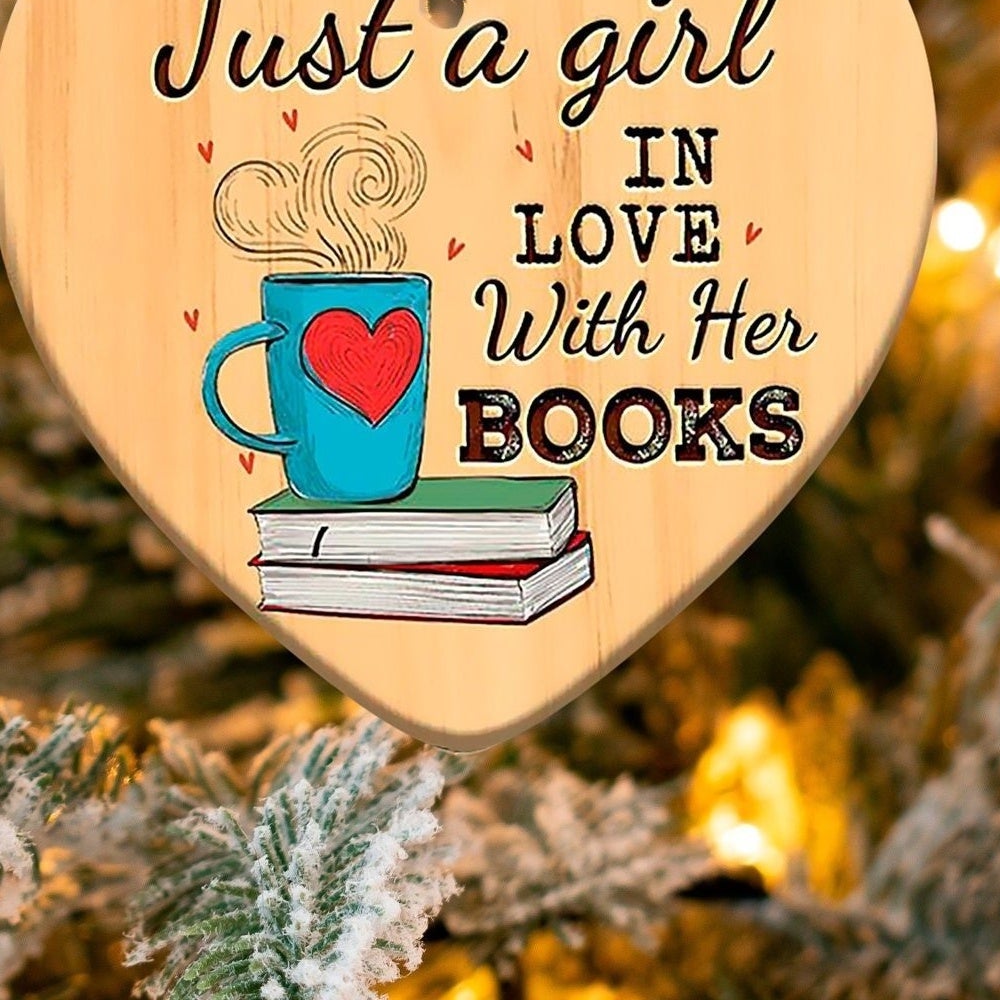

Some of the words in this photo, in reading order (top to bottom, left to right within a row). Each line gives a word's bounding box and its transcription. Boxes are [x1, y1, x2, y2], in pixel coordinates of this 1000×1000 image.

[442, 18, 528, 88] a
[624, 126, 719, 188] IN
[515, 203, 721, 265] LOVE
[475, 279, 665, 362] With
[690, 278, 817, 362] Her
[458, 386, 804, 464] BOOKS
